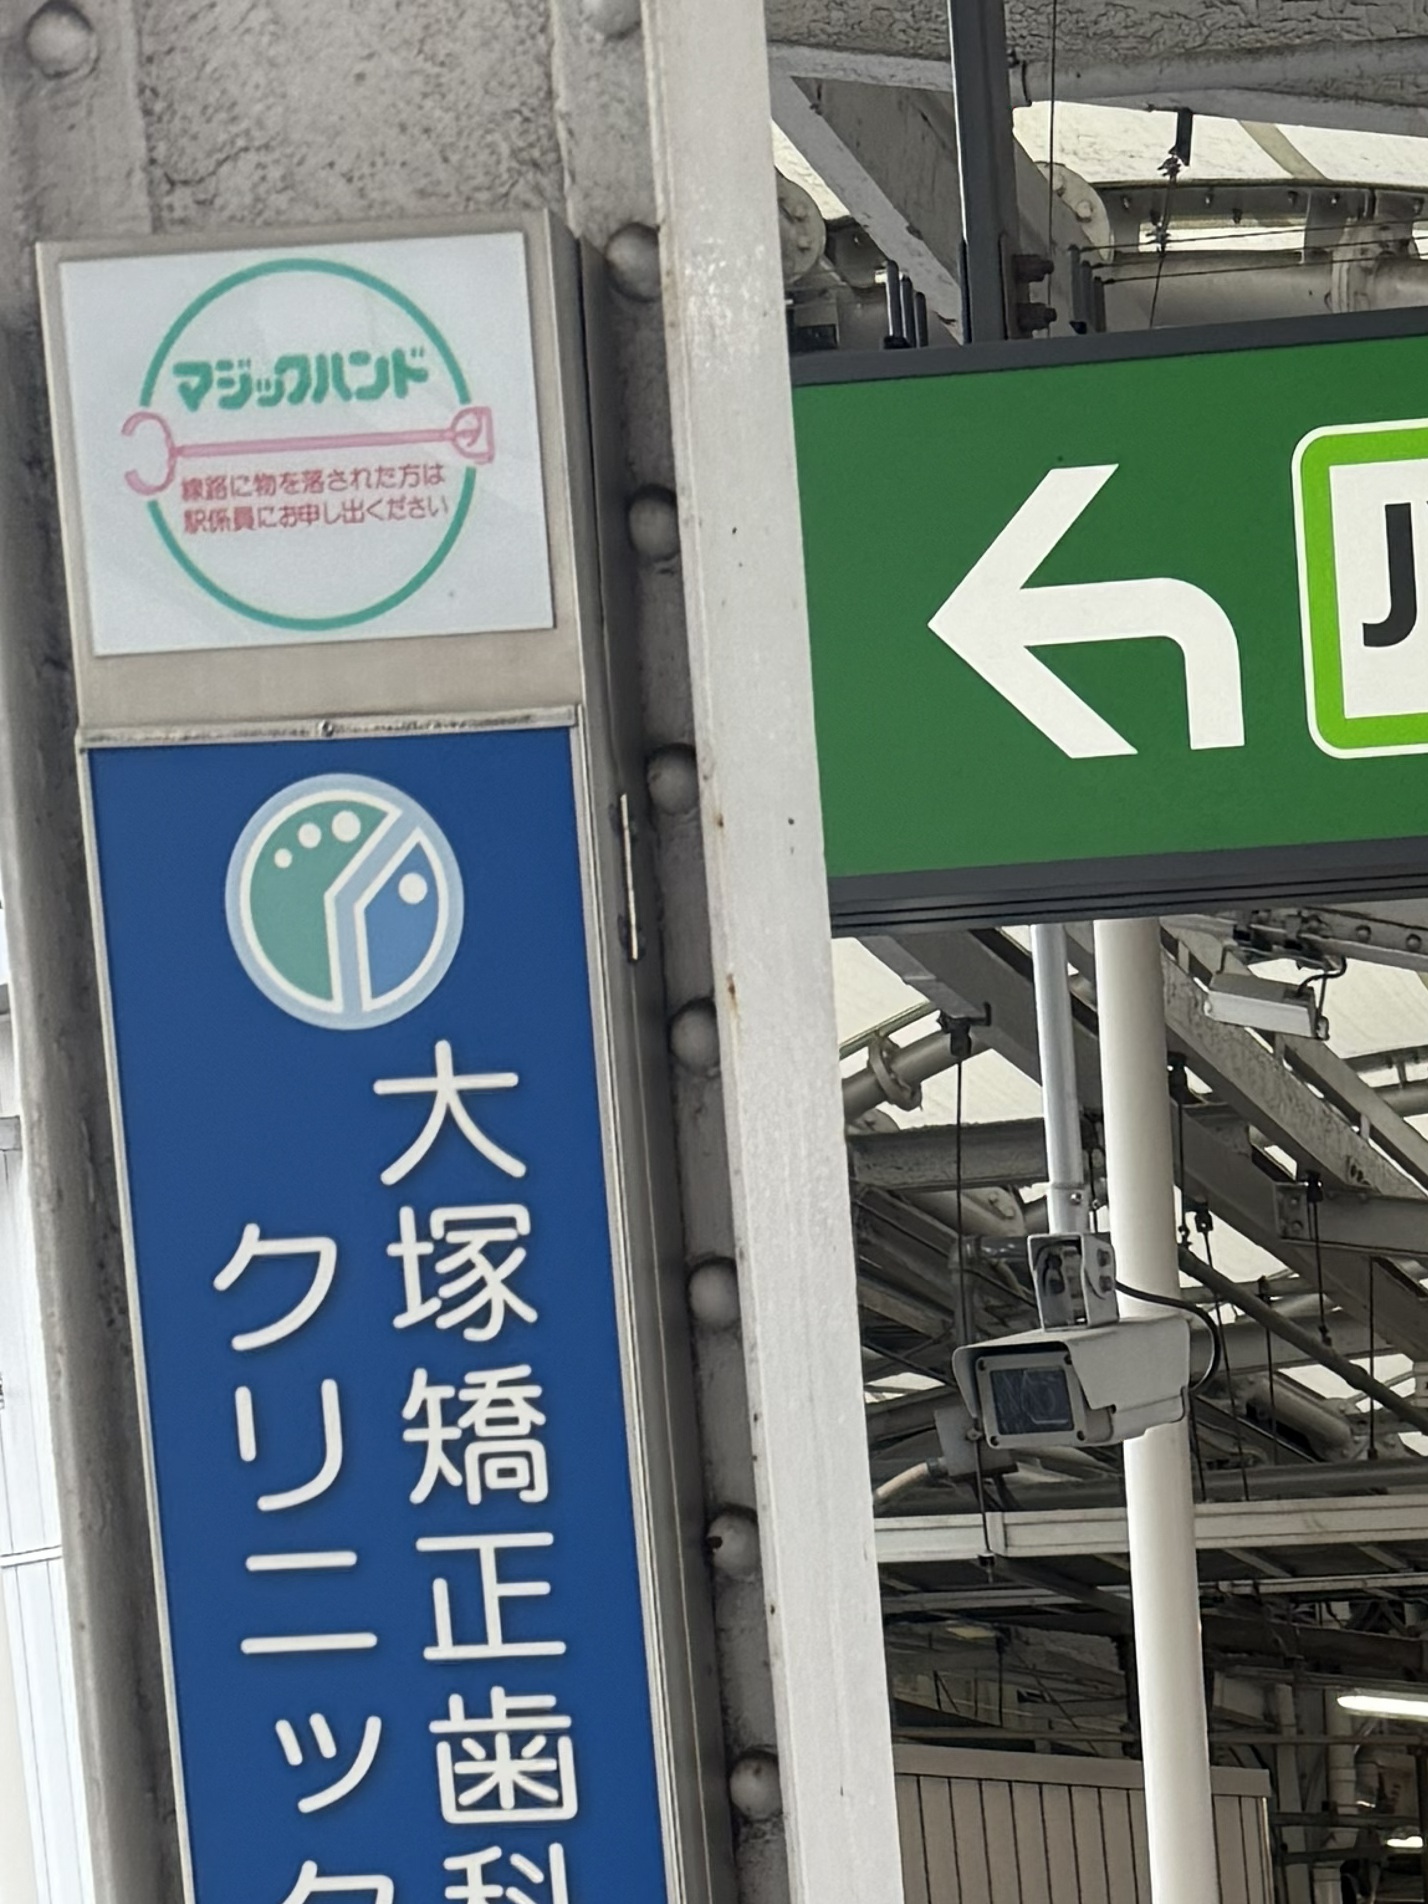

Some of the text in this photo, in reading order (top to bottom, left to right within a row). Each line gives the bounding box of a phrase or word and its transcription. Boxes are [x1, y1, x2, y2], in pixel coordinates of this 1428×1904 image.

[173, 347, 429, 413] マジックハンド
[181, 464, 445, 502] 線路に物を落された方は
[184, 496, 449, 534] 駅係員にお申し出ください
